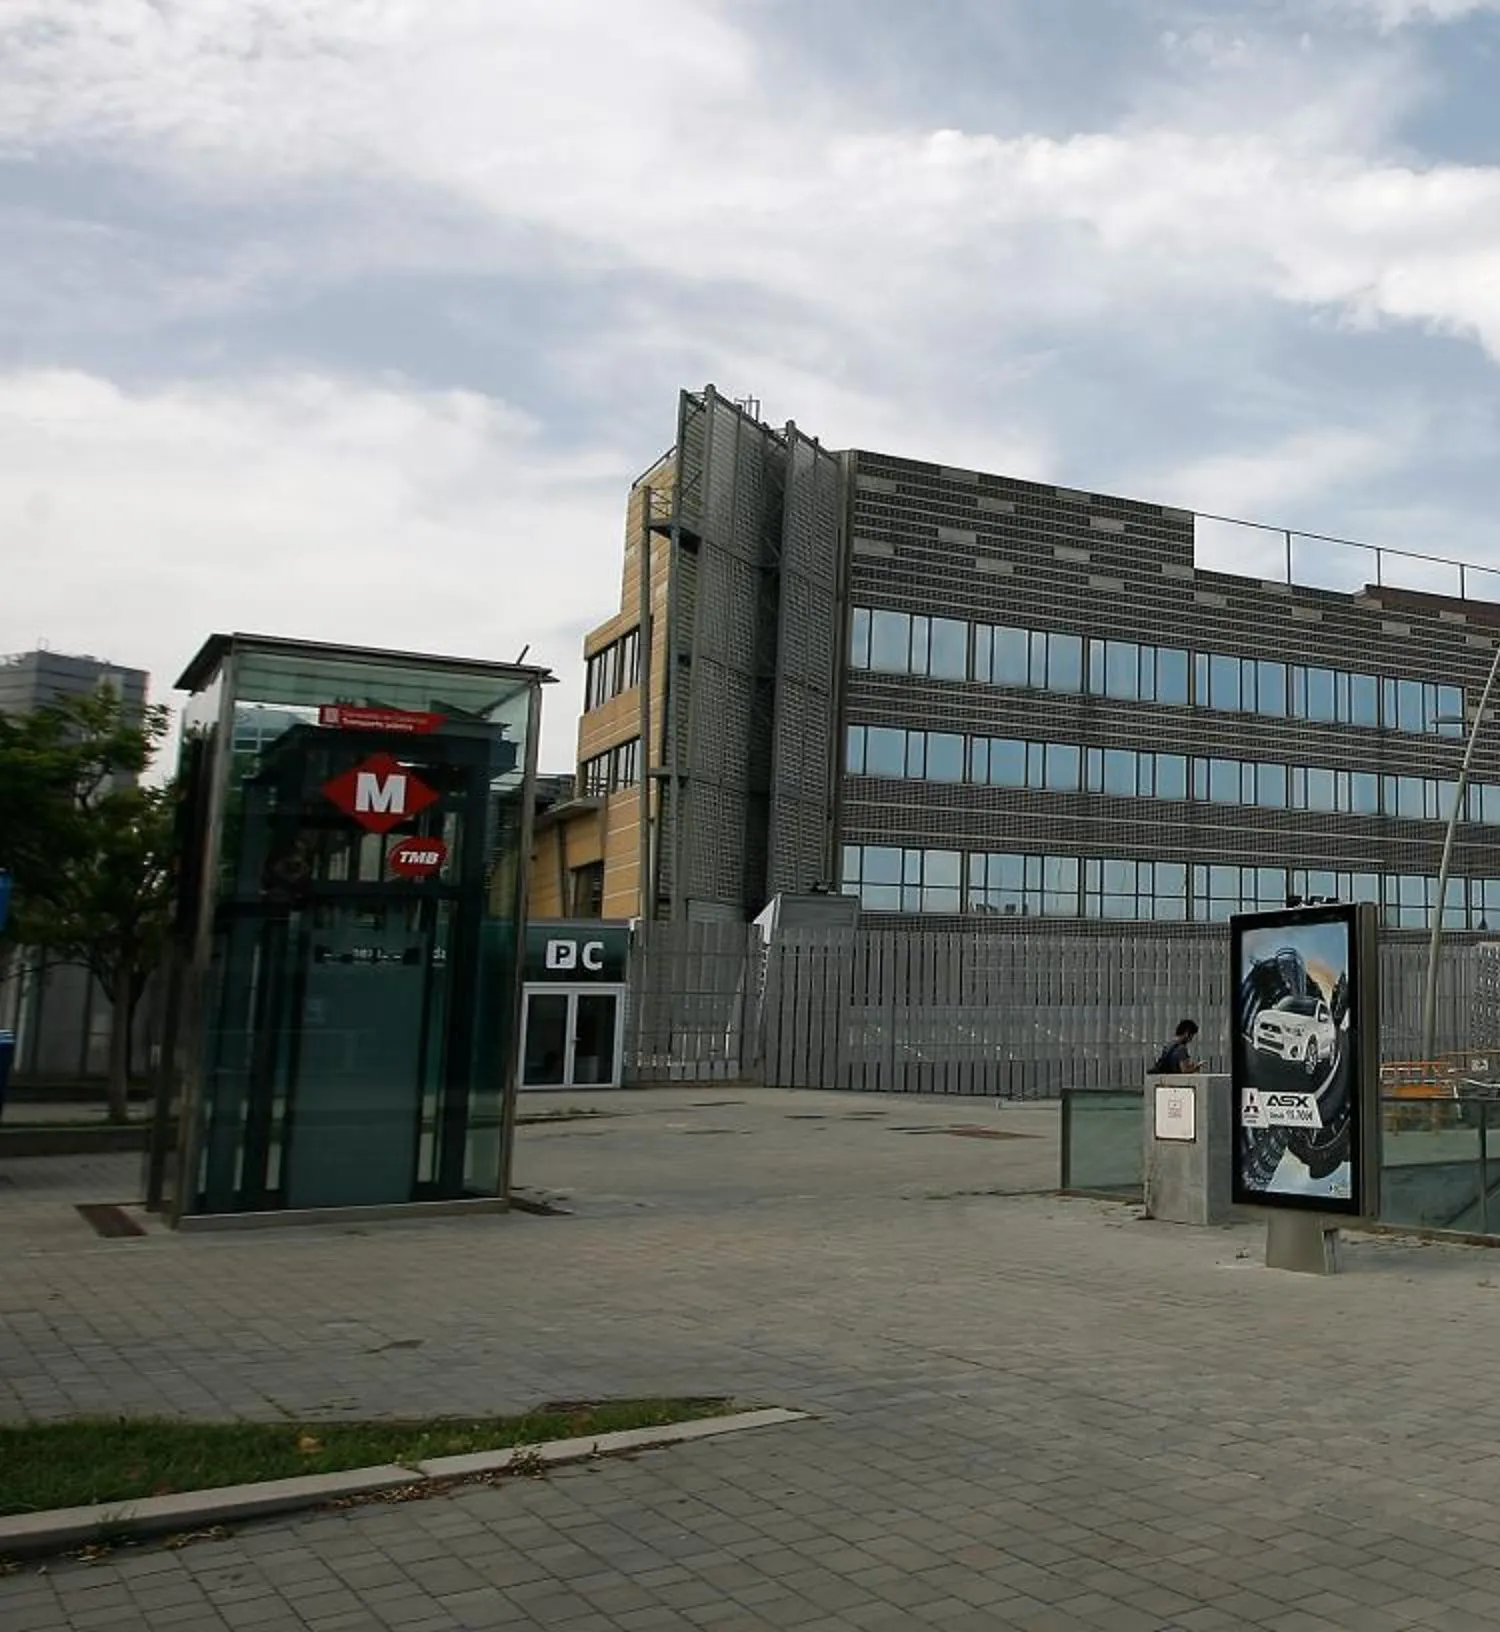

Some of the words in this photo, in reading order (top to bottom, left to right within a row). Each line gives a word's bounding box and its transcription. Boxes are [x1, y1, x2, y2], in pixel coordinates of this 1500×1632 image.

[355, 771, 406, 813] M
[399, 851, 439, 865] TMB
[1266, 1095, 1309, 1108] ASX
